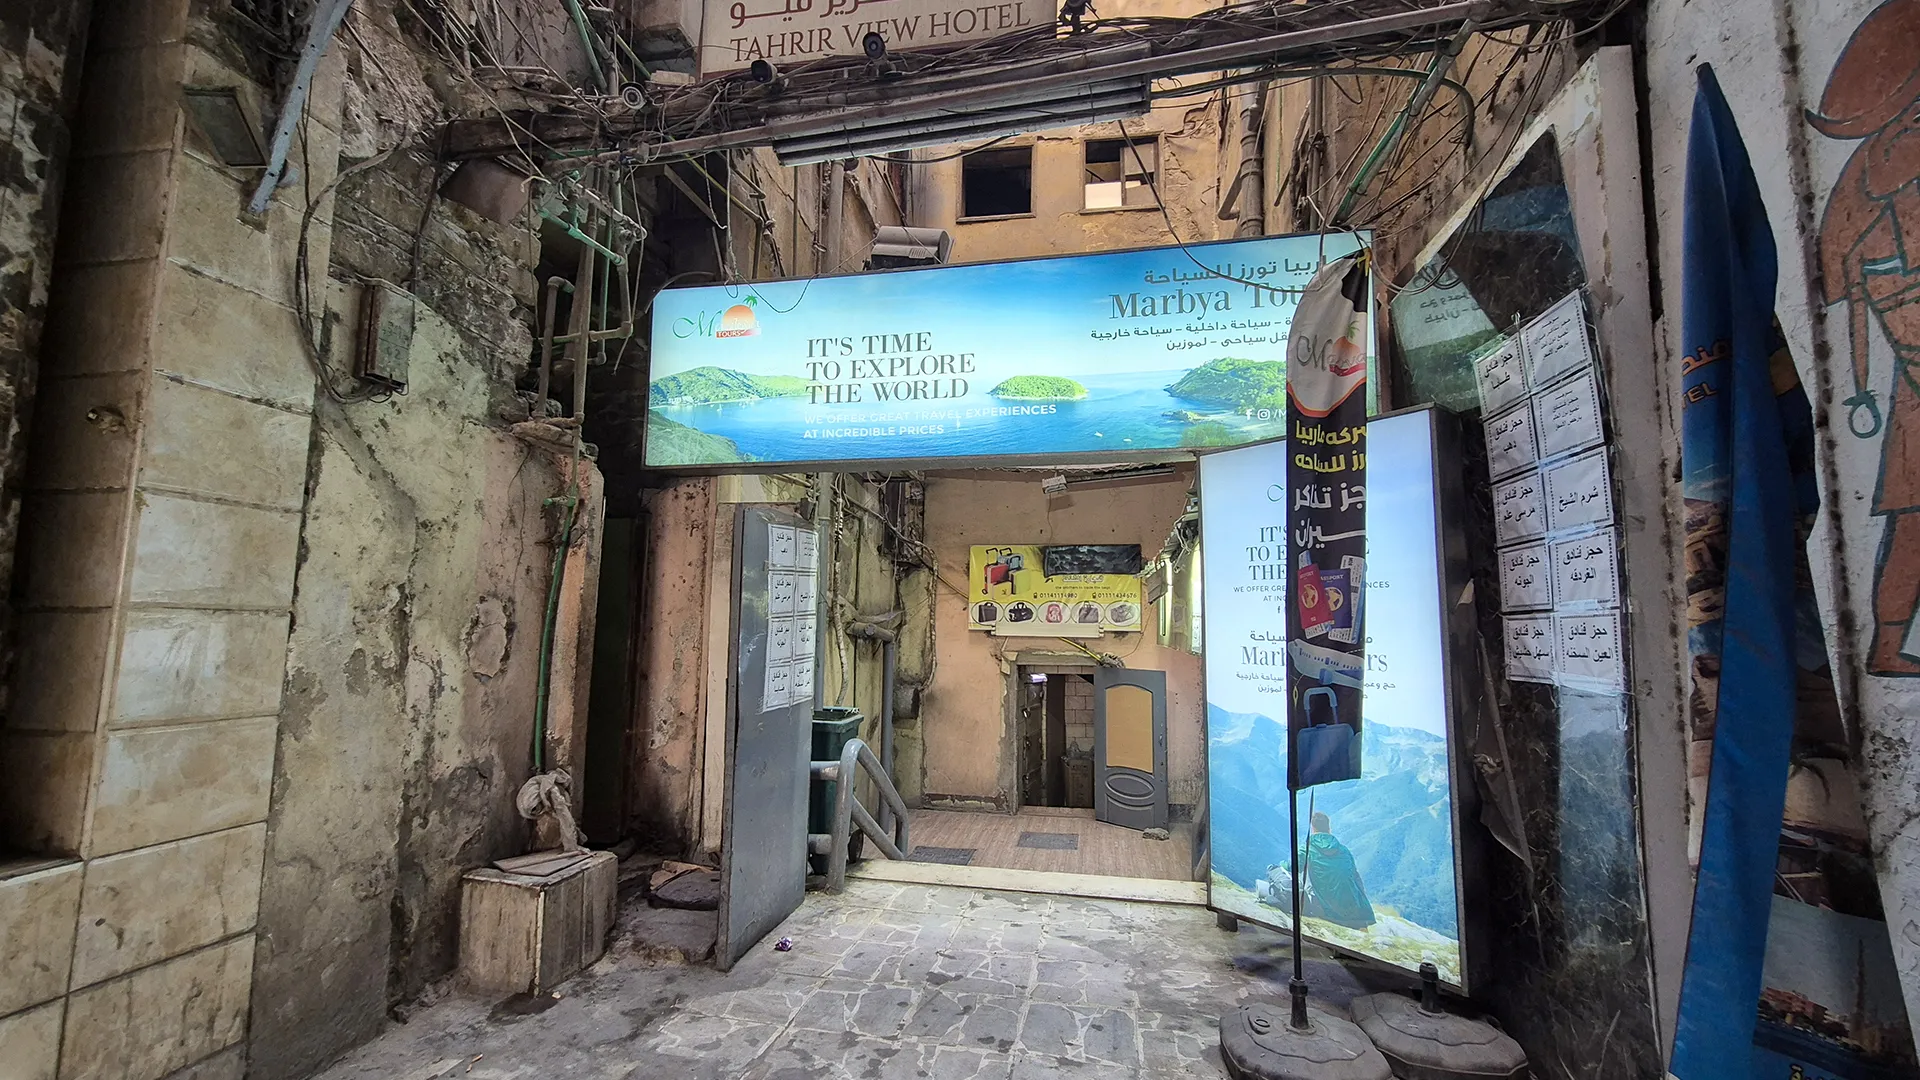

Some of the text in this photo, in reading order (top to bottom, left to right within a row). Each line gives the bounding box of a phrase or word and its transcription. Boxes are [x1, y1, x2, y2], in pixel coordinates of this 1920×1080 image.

[730, 27, 836, 62] TAHRIR
[929, 2, 1031, 38] HOTEL
[1143, 262, 1233, 286] للسياحة
[1239, 261, 1277, 281] تورز
[1109, 281, 1306, 321] Marbya Tou
[1133, 326, 1173, 338] سياحة
[1186, 322, 1228, 335] داخلية
[1230, 318, 1272, 331] سياحة
[717, 330, 741, 338] TOURS
[1090, 329, 1131, 341] خارجية
[806, 332, 932, 358] IT'S TIME
[1166, 337, 1208, 351] لموزين
[806, 353, 976, 381] TO EXPLORE
[805, 378, 969, 405] THE WORLD
[804, 404, 1057, 424] WE OFFER GREAT TRAVEL EXPERIENCES
[803, 424, 945, 439] AT INCREDIBLE PRICES
[1519, 486, 1534, 500] حجز
[1245, 545, 1271, 562] TO
[1526, 555, 1540, 568] حجز
[1562, 544, 1604, 566] حجز فنادق
[1531, 626, 1545, 640] حجز
[1568, 621, 1608, 641] حجز فنادق
